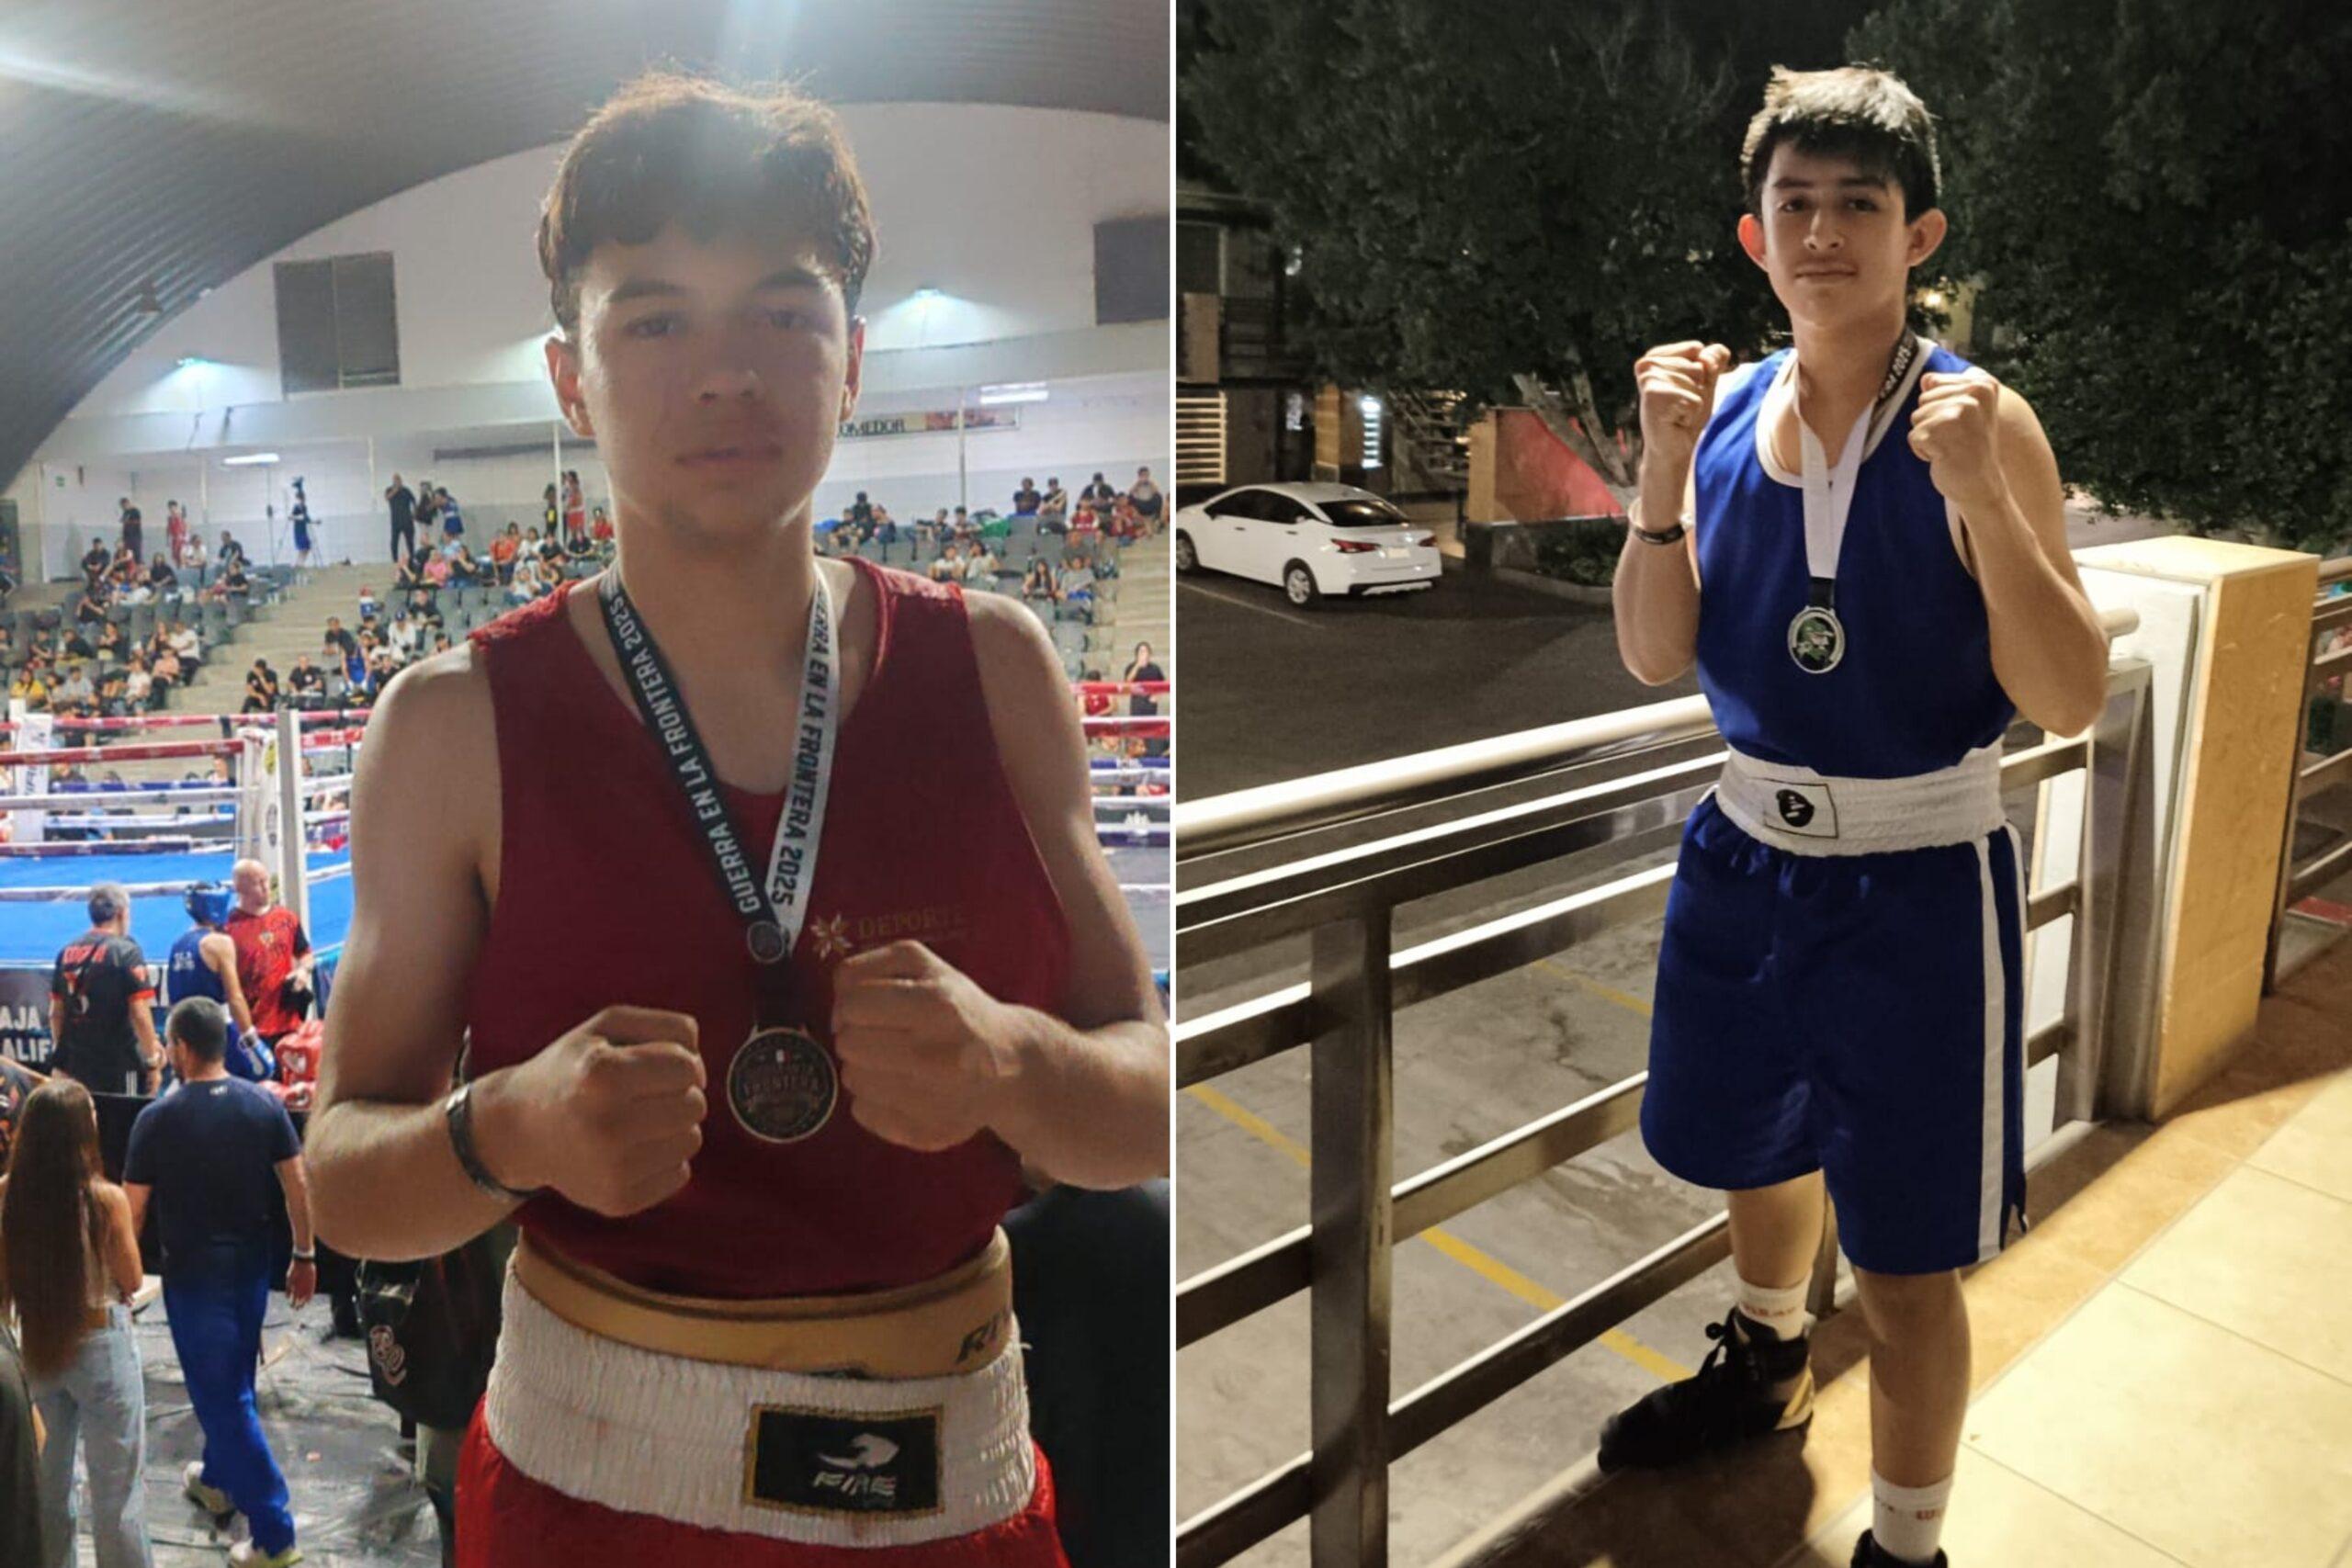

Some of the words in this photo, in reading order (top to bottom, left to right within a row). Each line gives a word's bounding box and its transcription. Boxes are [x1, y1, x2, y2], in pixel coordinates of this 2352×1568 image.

[838, 418, 905, 437] OMEDOR
[609, 596, 643, 650] 2025
[808, 659, 829, 685] EN
[631, 648, 693, 757] FRONTERA
[803, 693, 828, 719] LA
[679, 757, 707, 788] LA
[784, 724, 822, 840] FRONTERA
[692, 788, 723, 820] EN
[707, 822, 761, 913] GUERRA
[769, 844, 803, 907] 2025
